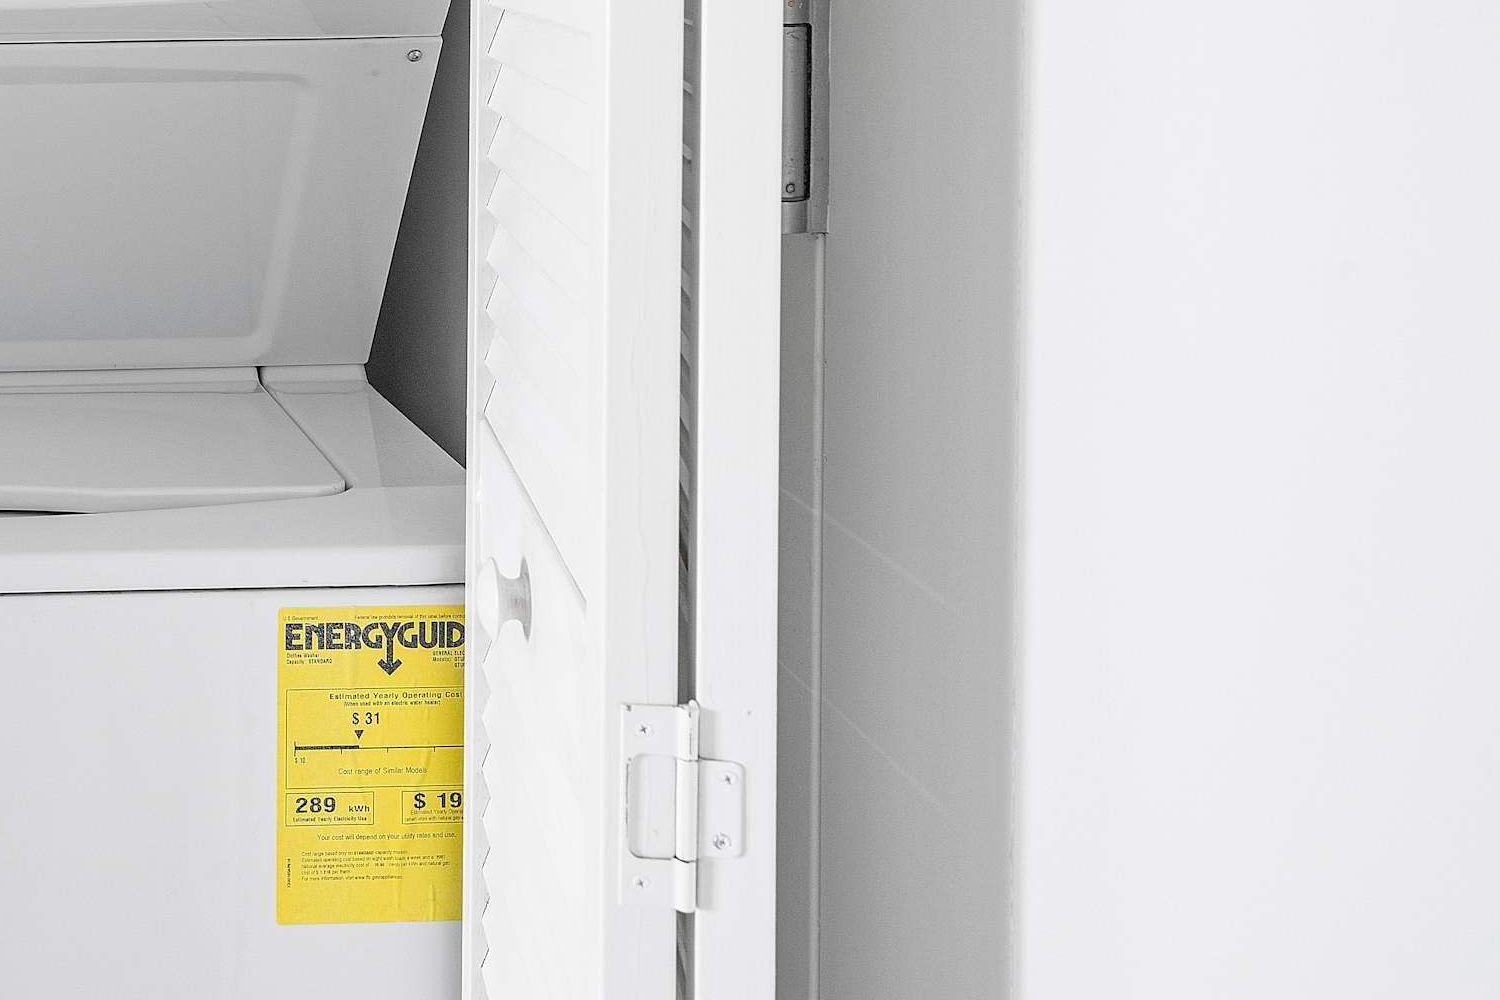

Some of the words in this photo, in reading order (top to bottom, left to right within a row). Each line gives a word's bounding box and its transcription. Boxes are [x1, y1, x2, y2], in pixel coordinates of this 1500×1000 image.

[285, 621, 465, 651] ENERGYGUID
[373, 692, 399, 700] Yearly
[402, 691, 442, 699] Operating
[365, 712, 380, 725] 31
[295, 797, 336, 814] 289
[356, 833, 377, 841] depend
